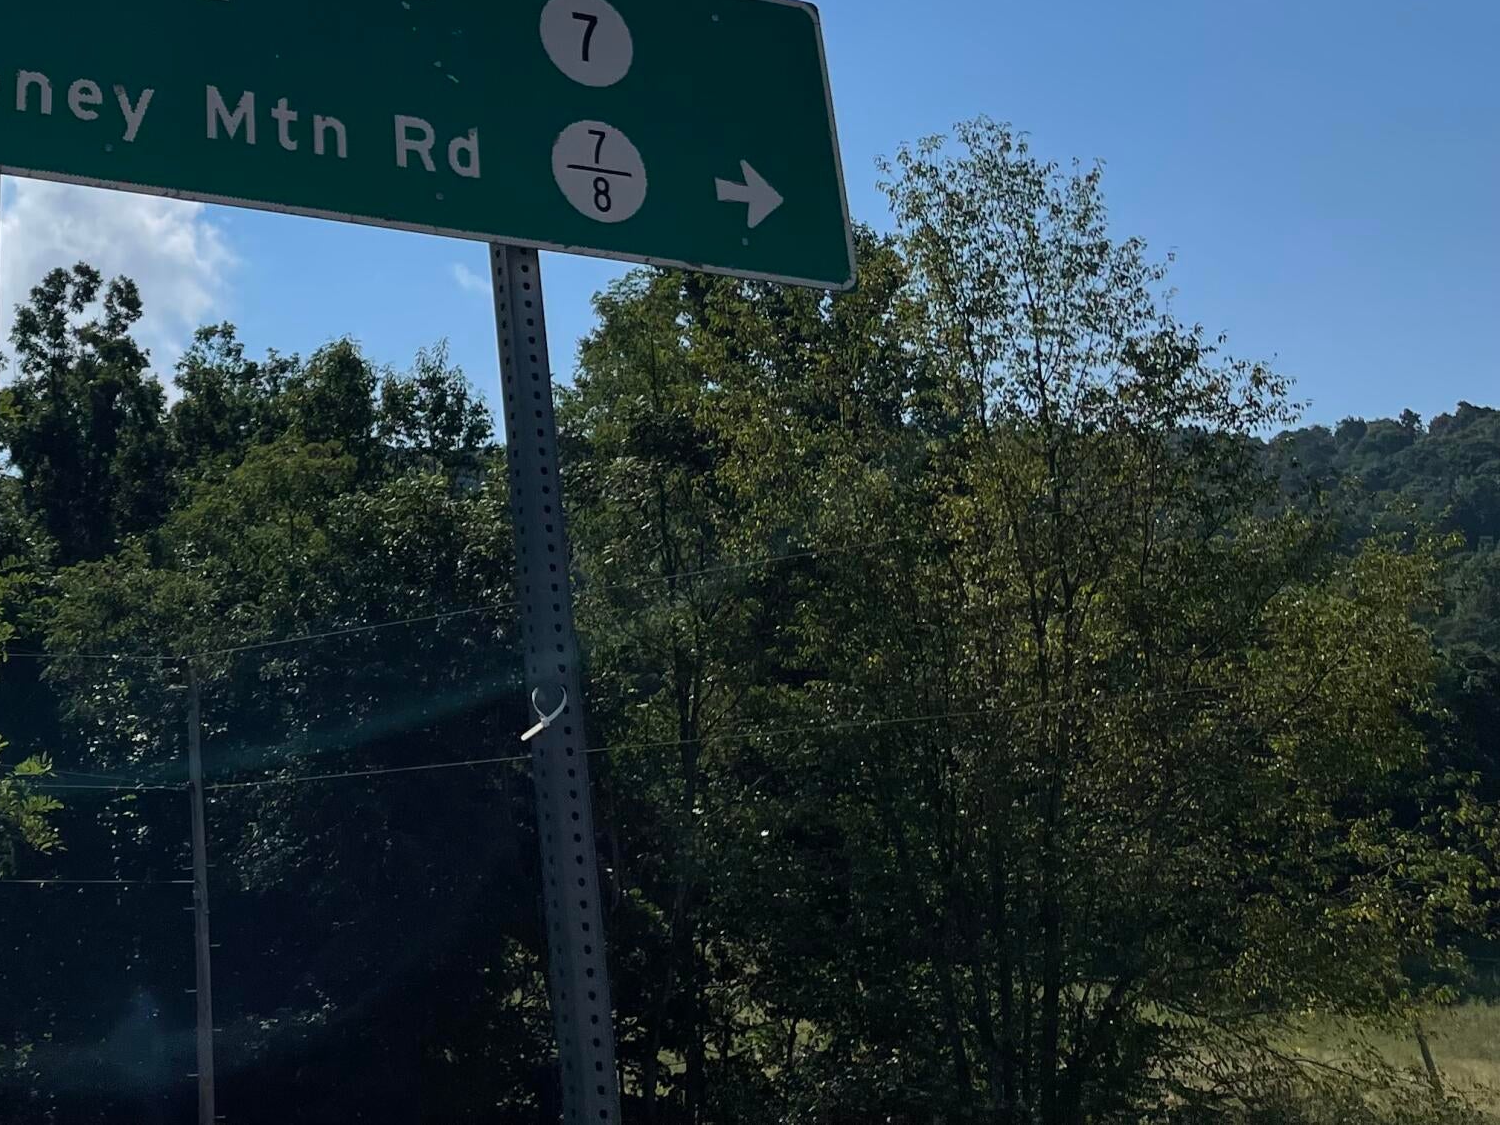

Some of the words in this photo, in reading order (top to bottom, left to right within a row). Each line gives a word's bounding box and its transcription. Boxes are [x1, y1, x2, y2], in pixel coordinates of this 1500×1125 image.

[571, 11, 598, 62] 7
[206, 84, 347, 158] Mtn
[394, 114, 481, 179] Rd
[587, 129, 606, 164] 7
[593, 176, 612, 213] 8
